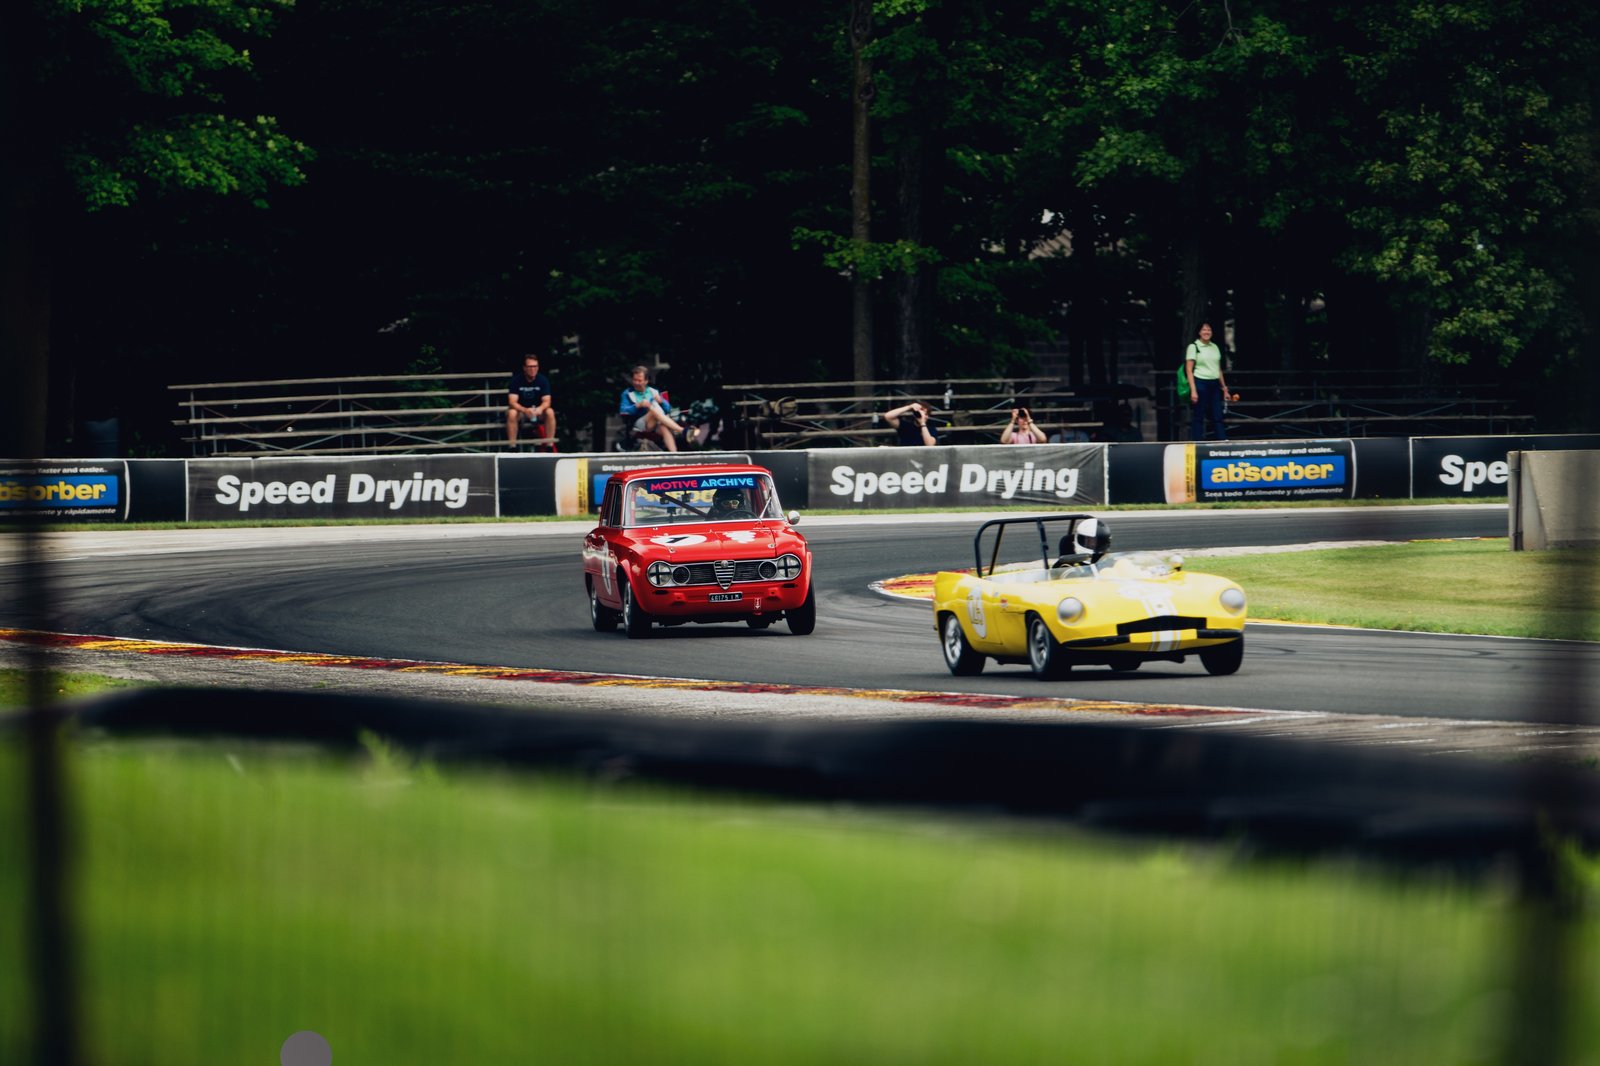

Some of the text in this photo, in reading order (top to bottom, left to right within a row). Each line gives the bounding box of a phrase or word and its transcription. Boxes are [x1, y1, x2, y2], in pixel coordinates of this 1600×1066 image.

[1230, 449, 1267, 458] anything
[650, 477, 755, 492] MOTIVE ARCHIVE
[829, 462, 1079, 502] Speed Drying
[1211, 462, 1334, 483] absorber
[1439, 454, 1508, 492] Spe
[215, 472, 469, 512] Speed Drying
